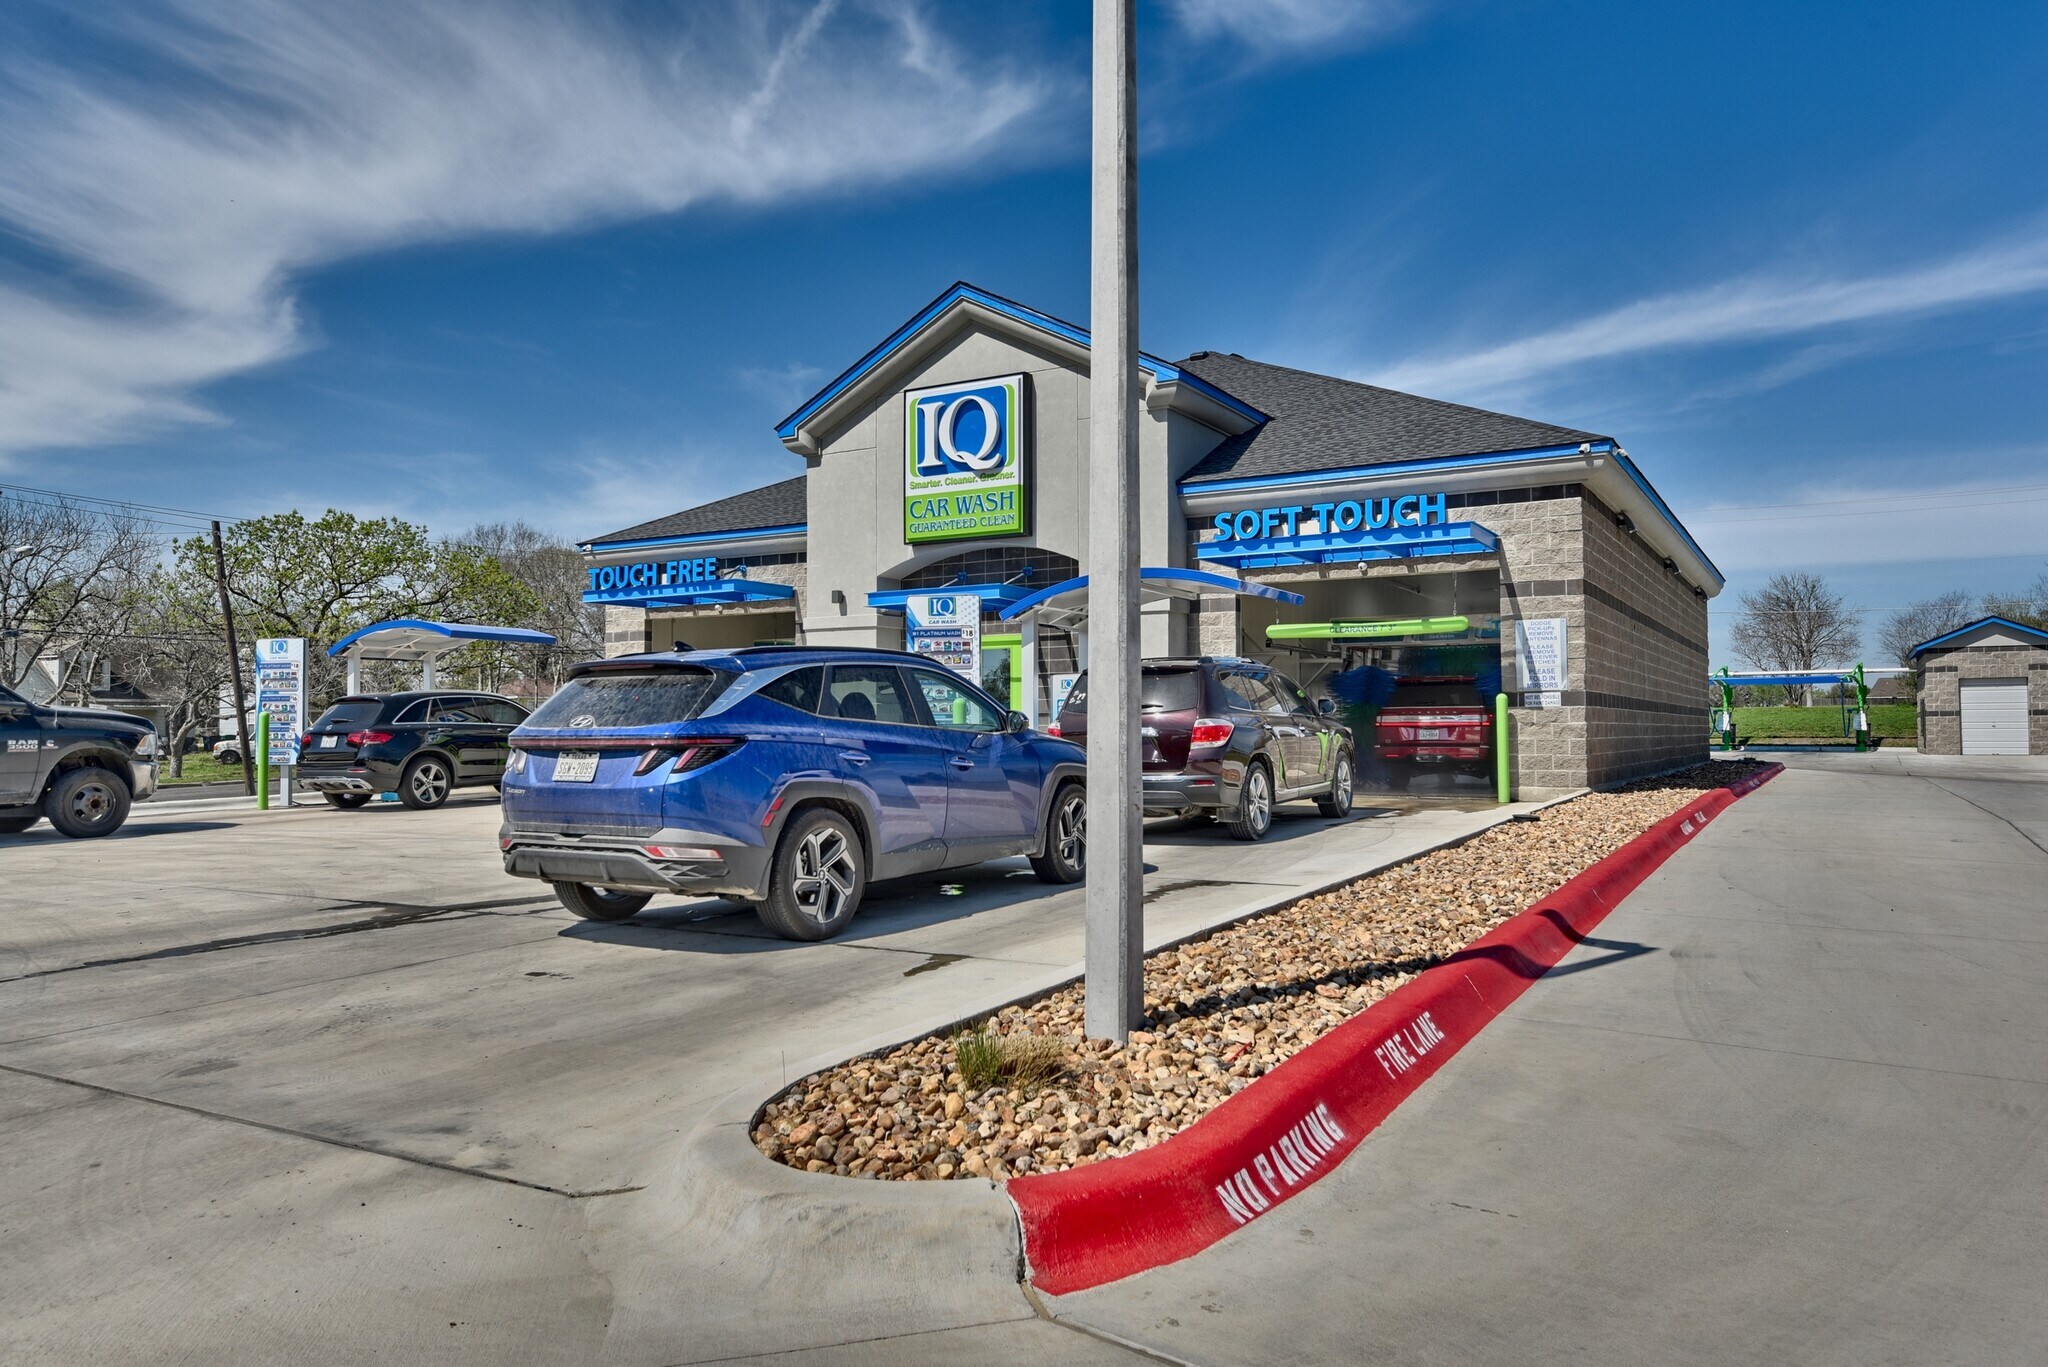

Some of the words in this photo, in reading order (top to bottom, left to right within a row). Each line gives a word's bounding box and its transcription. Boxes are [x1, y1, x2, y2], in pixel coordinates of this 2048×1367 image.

[917, 395, 1003, 471] IQ
[909, 479, 943, 490] Smarter.
[945, 475, 978, 487] Cleaner.
[909, 496, 949, 519] CAR
[956, 490, 1015, 515] WASH
[909, 516, 977, 533] GUARANTEED
[979, 513, 1015, 527] CLEAN
[1214, 505, 1304, 542] SOFT
[1313, 492, 1446, 533] TOUCH
[588, 562, 658, 591] TOUCH
[666, 556, 720, 585] FREE
[932, 598, 954, 616] IQ
[1329, 625, 1377, 634] CLEARANCE
[272, 641, 287, 655] IQ
[1216, 1167, 1269, 1225] NO
[1253, 1102, 1346, 1196] PARKING
[1374, 1033, 1416, 1080] FIRE
[1402, 1011, 1445, 1056] LANE
